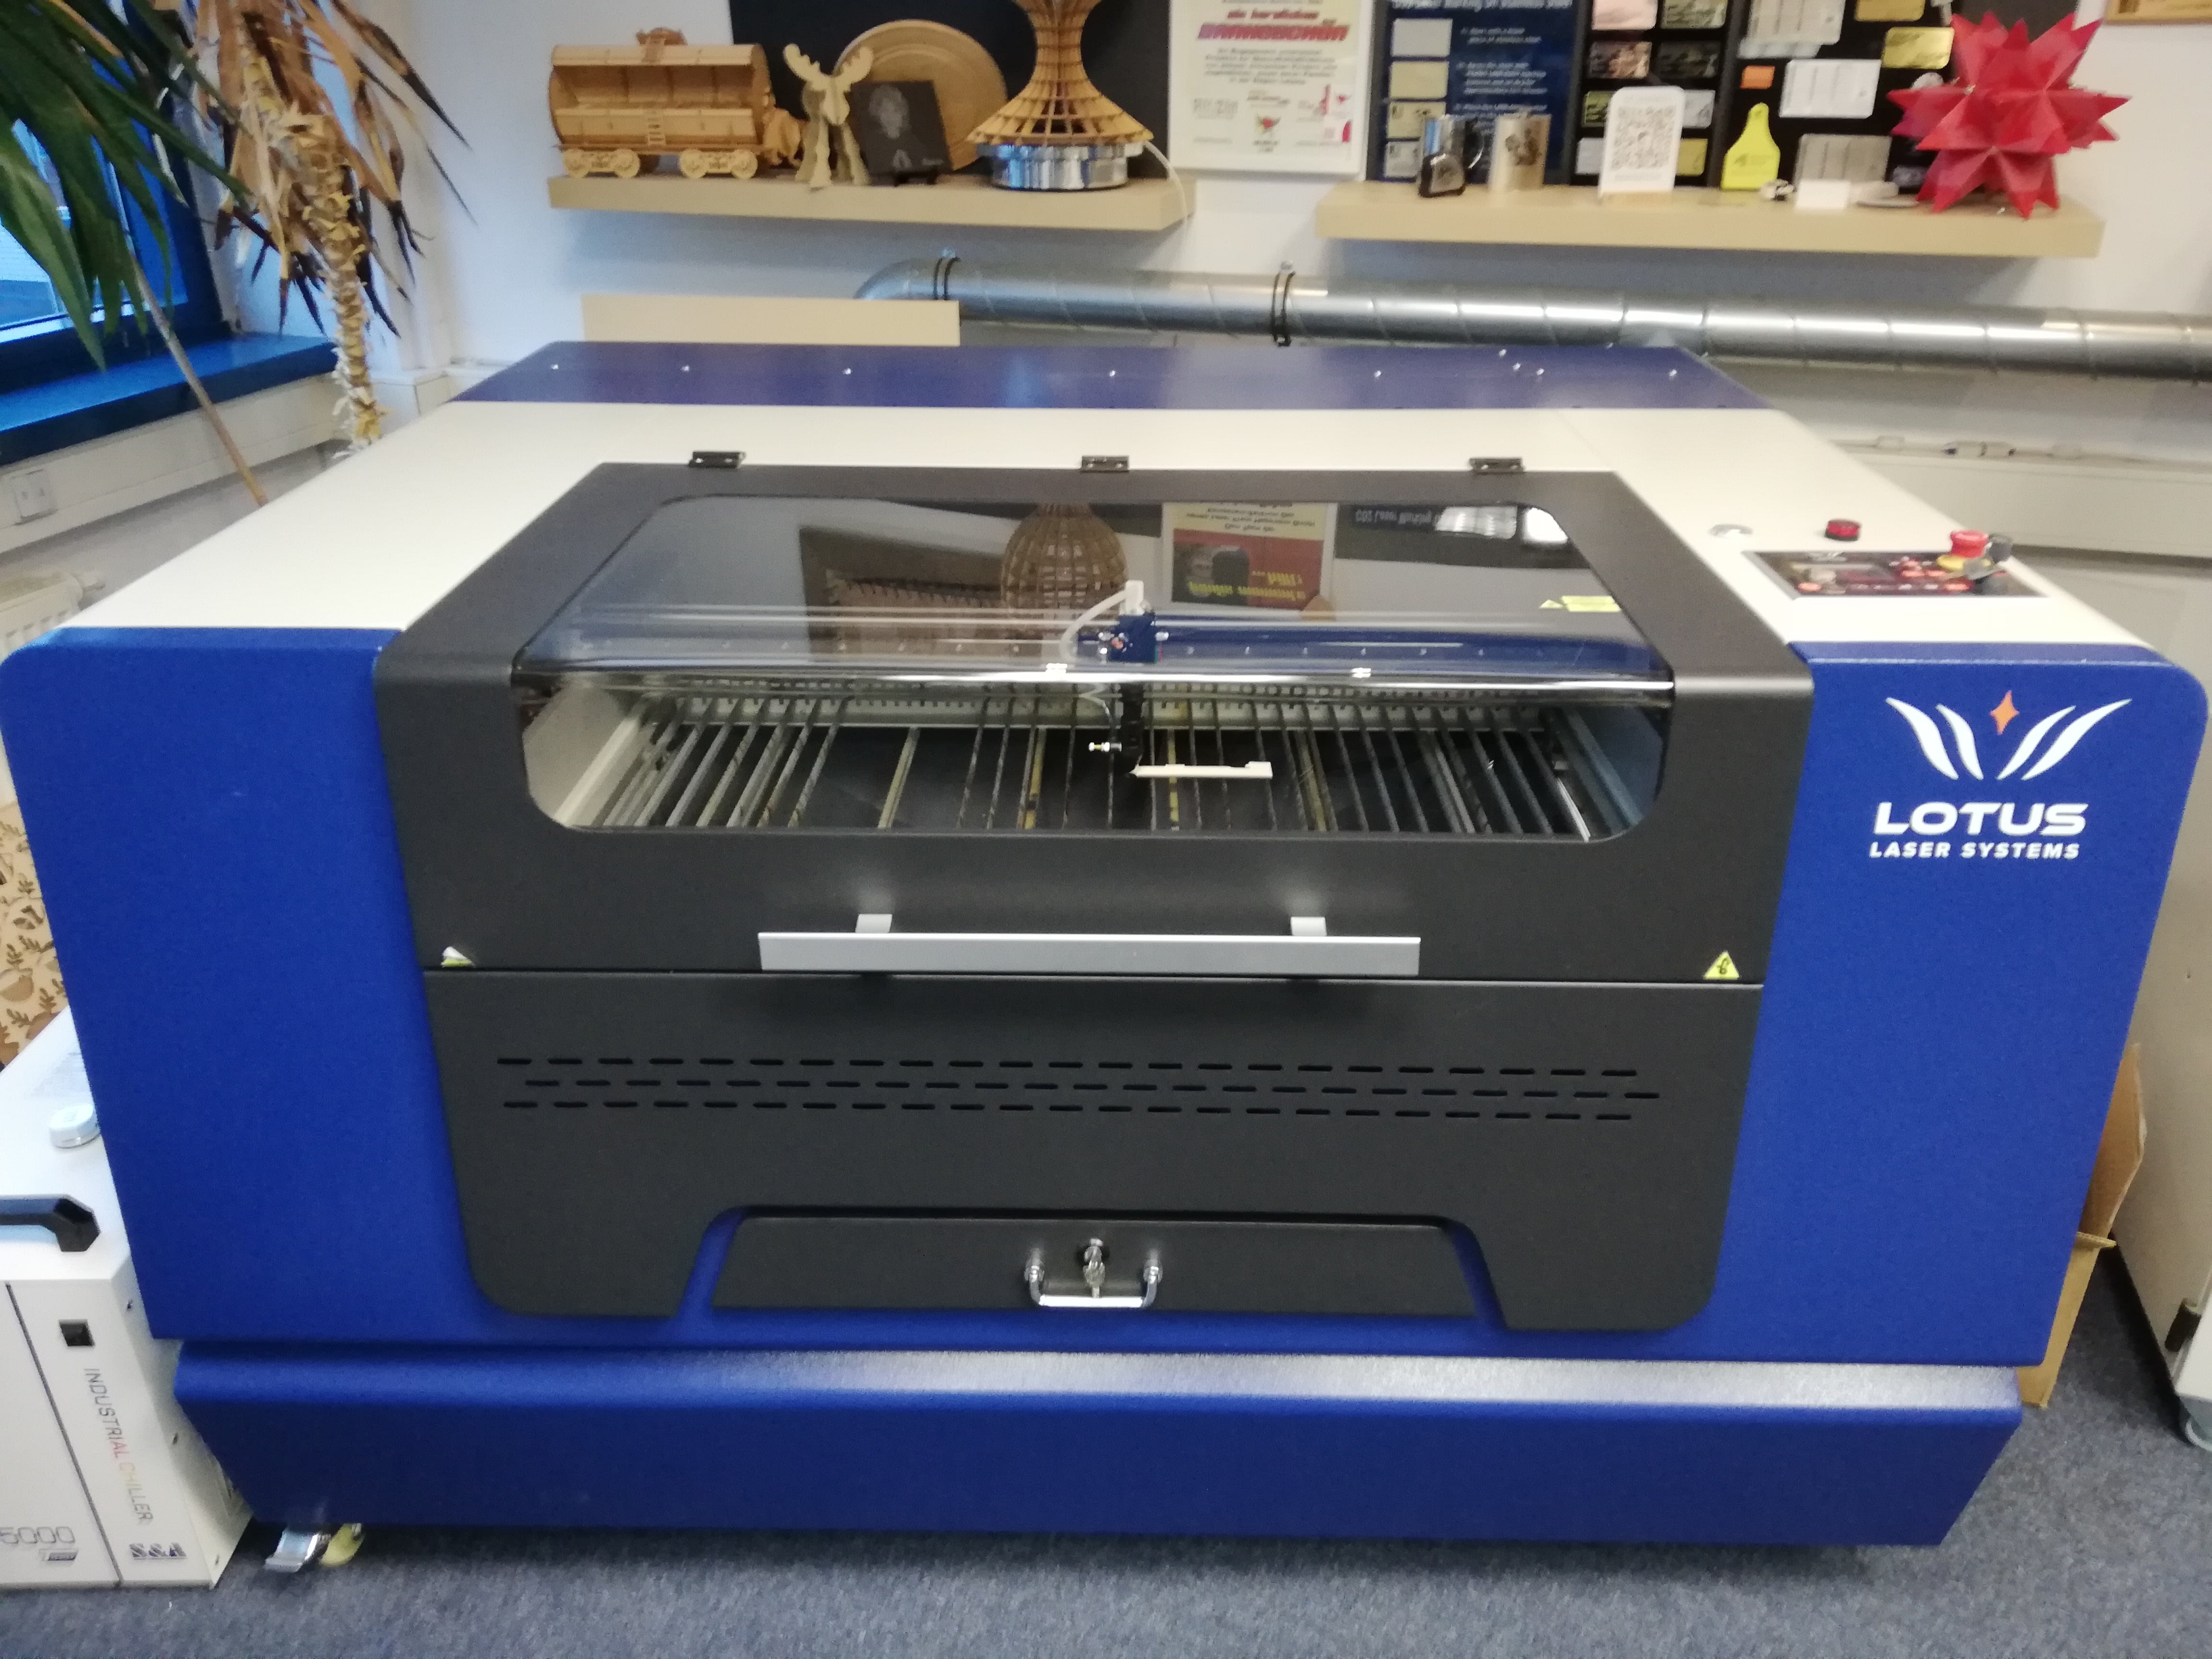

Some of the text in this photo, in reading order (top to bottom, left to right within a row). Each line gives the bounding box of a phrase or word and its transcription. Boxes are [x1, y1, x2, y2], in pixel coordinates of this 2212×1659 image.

[1874, 802, 2088, 836] LOTUS
[1869, 842, 2080, 859] LASER SYSTEMS
[84, 1368, 154, 1520] INDUSTRIAL CHILLER
